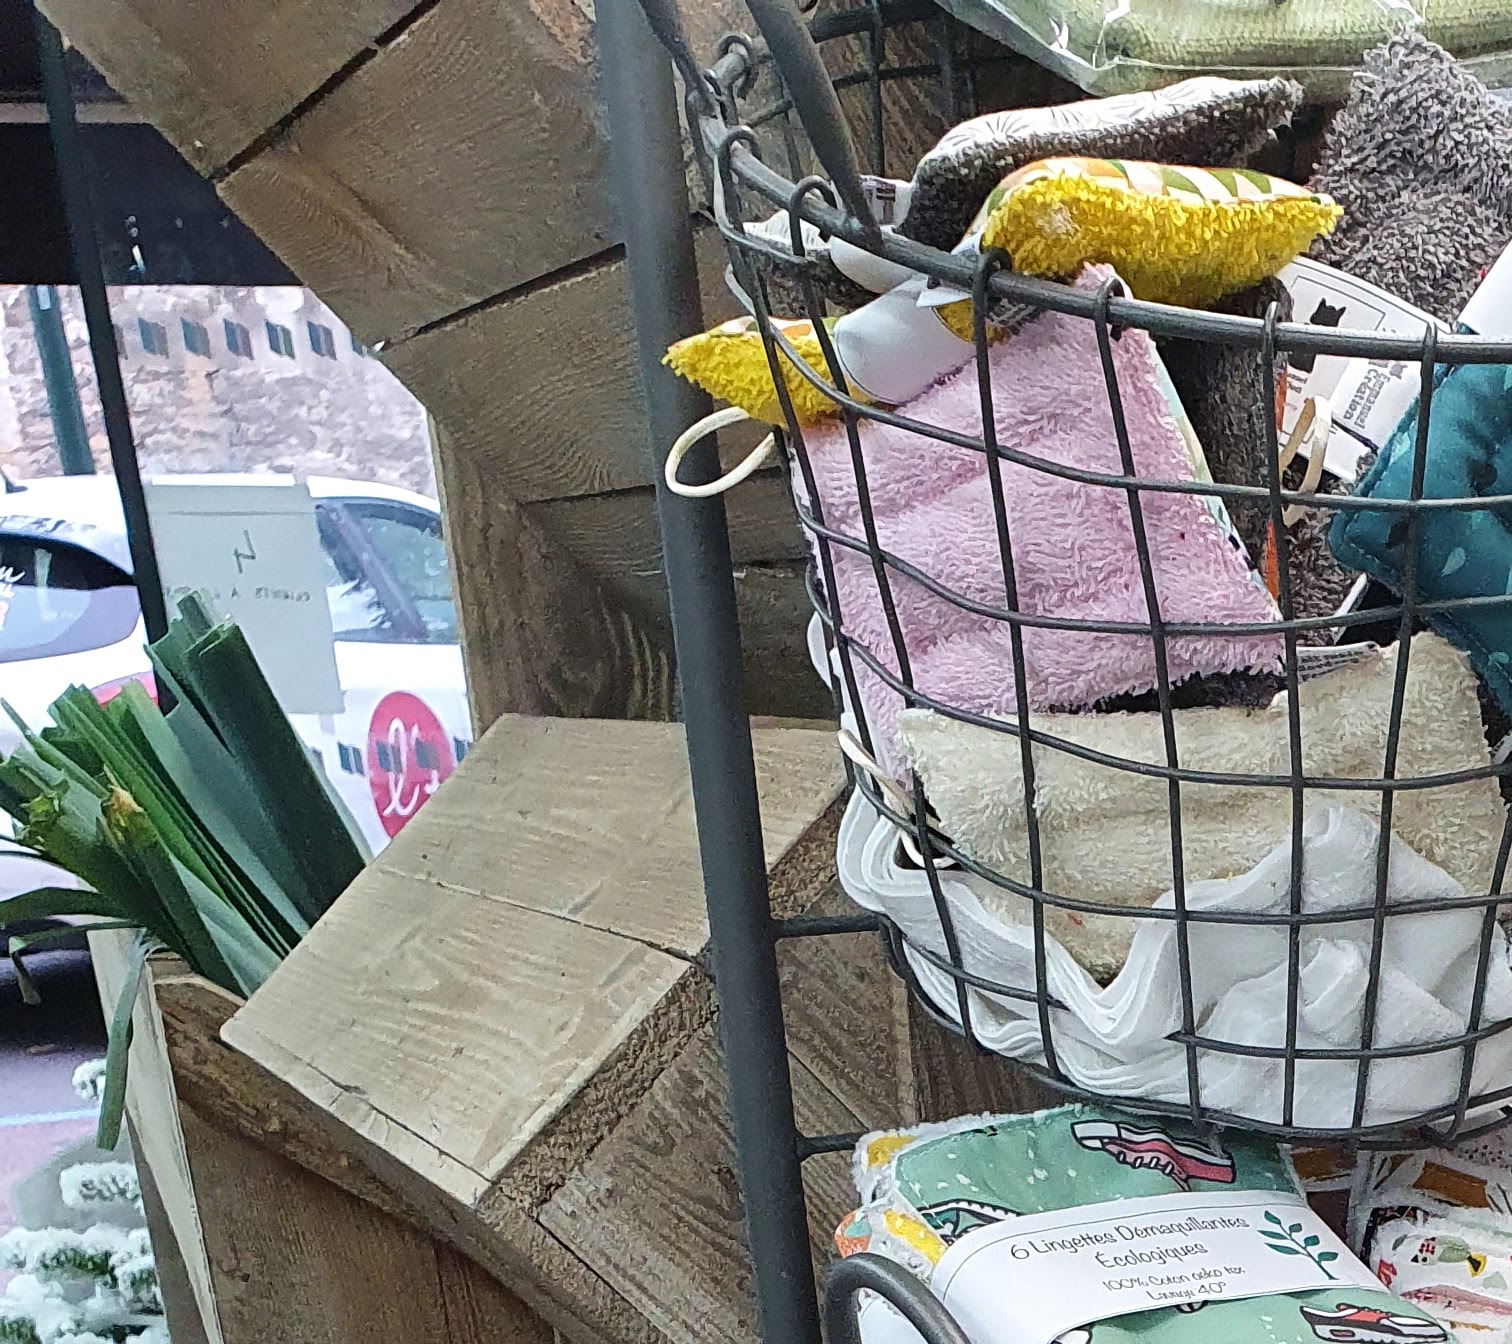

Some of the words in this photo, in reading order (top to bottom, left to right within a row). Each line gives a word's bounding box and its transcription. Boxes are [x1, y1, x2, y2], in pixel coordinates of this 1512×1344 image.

[1010, 1244, 1029, 1260] 6
[1029, 1229, 1117, 1255] Lingettes
[1115, 1217, 1250, 1242] Démaquillantes
[1095, 1242, 1209, 1268] Écologiques
